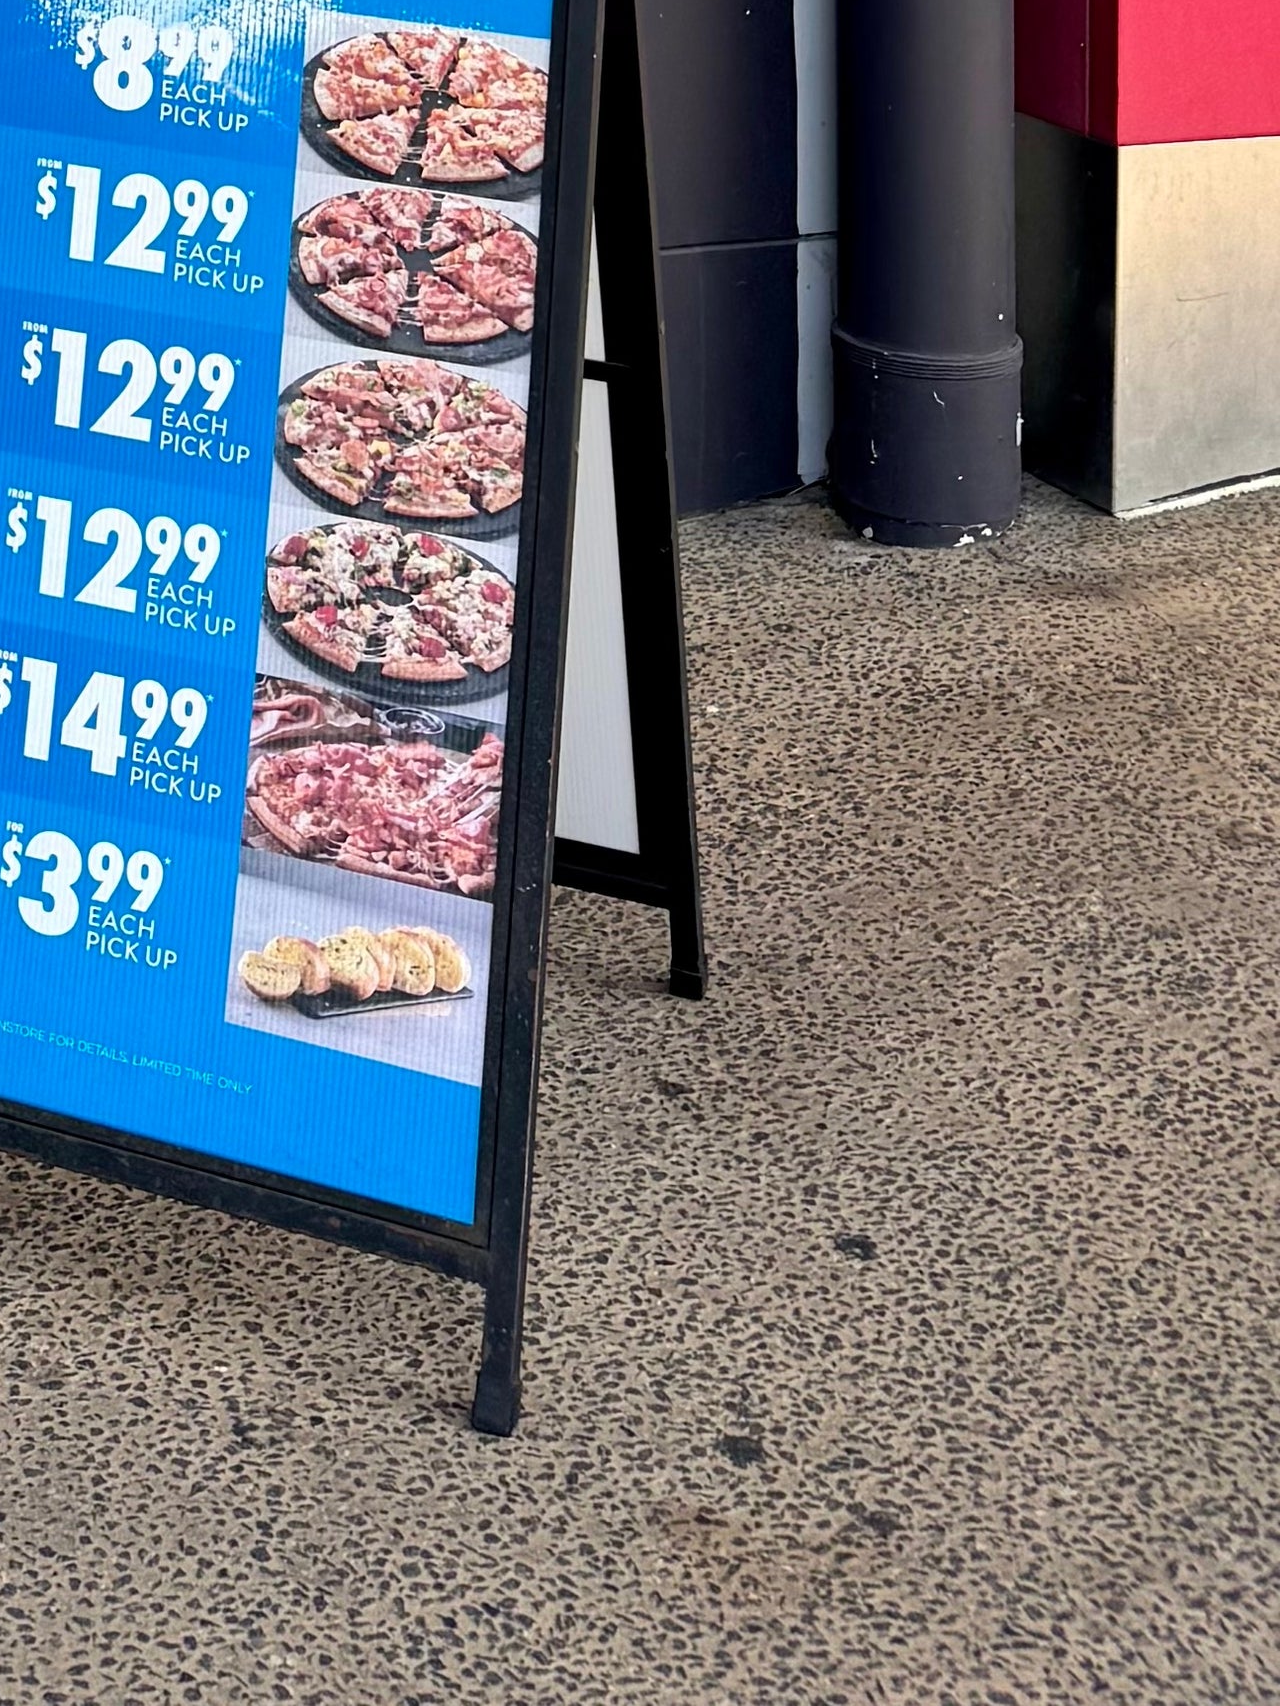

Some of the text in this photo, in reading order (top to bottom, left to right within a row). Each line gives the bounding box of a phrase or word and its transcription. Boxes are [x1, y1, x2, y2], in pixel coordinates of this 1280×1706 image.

[162, 80, 227, 107] EACH
[159, 103, 249, 133] PICK UP
[176, 239, 241, 268] EACH
[173, 262, 265, 294] PICK UP
[161, 407, 229, 437] EACH
[159, 432, 251, 464] PICK UP
[147, 578, 214, 609] EACH
[145, 604, 237, 637] PICK UP
[132, 742, 200, 774] EACH
[129, 769, 223, 804] PICK UP
[88, 906, 156, 939] EACH
[86, 931, 178, 970] PICK UP
[49, 1032, 74, 1048] FOR
[132, 1054, 182, 1077] LIMITED
[185, 1067, 214, 1085] TIME
[217, 1076, 253, 1095] ONLY
